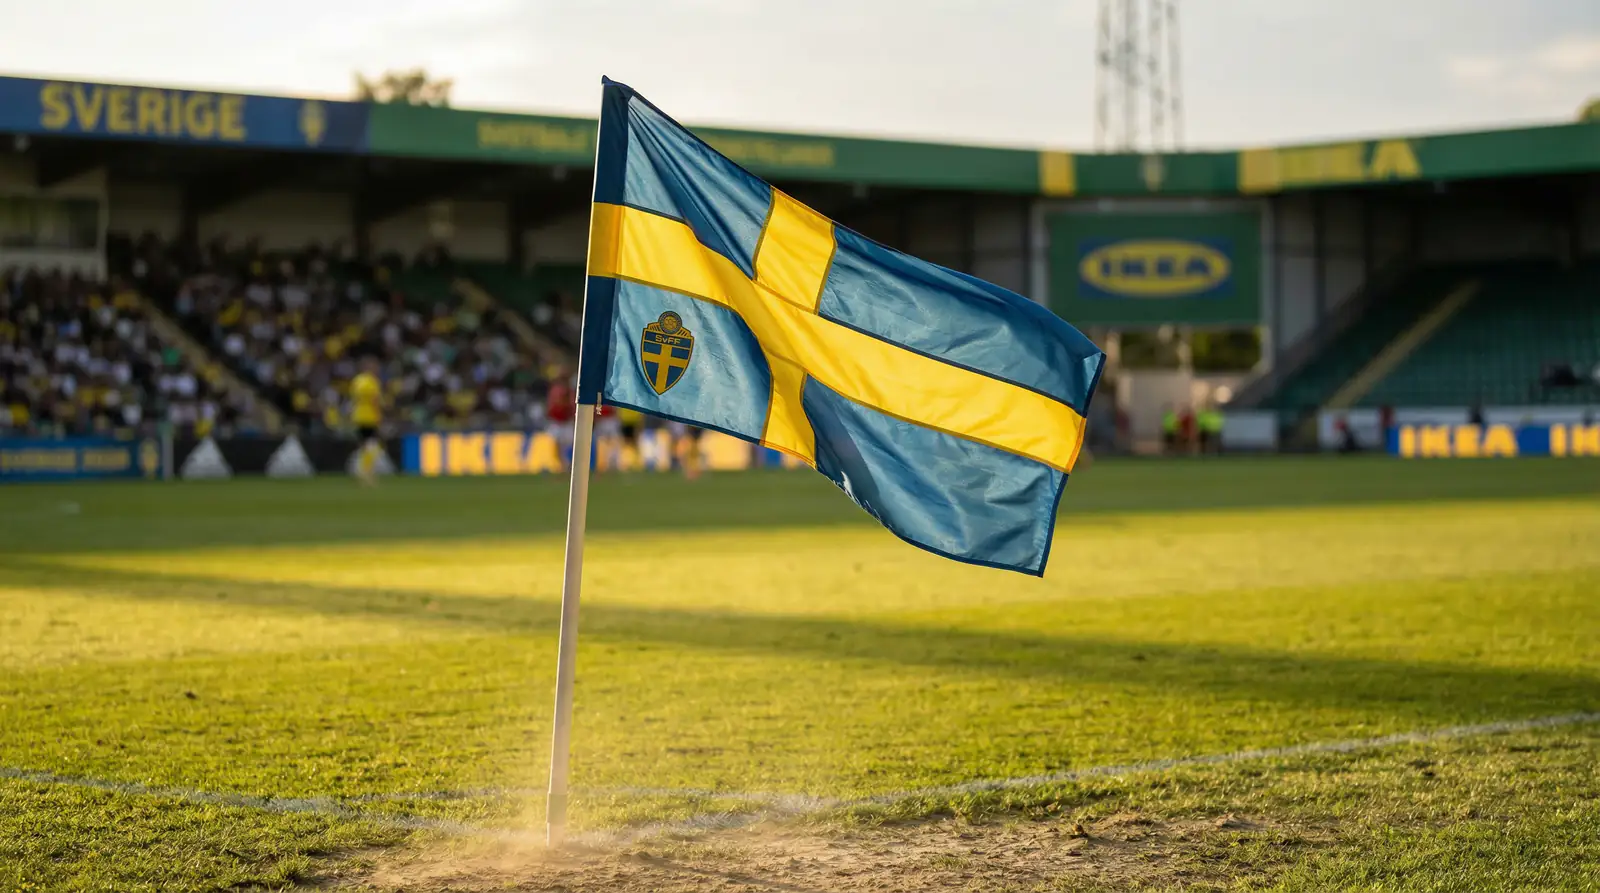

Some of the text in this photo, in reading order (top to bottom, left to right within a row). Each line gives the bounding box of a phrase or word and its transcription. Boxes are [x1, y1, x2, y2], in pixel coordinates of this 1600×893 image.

[39, 81, 246, 141] SVERIGE
[1100, 256, 1212, 278] IKEA
[655, 334, 681, 345] SvFF
[419, 432, 563, 476] IKEA
[1401, 424, 1519, 457] IKEA
